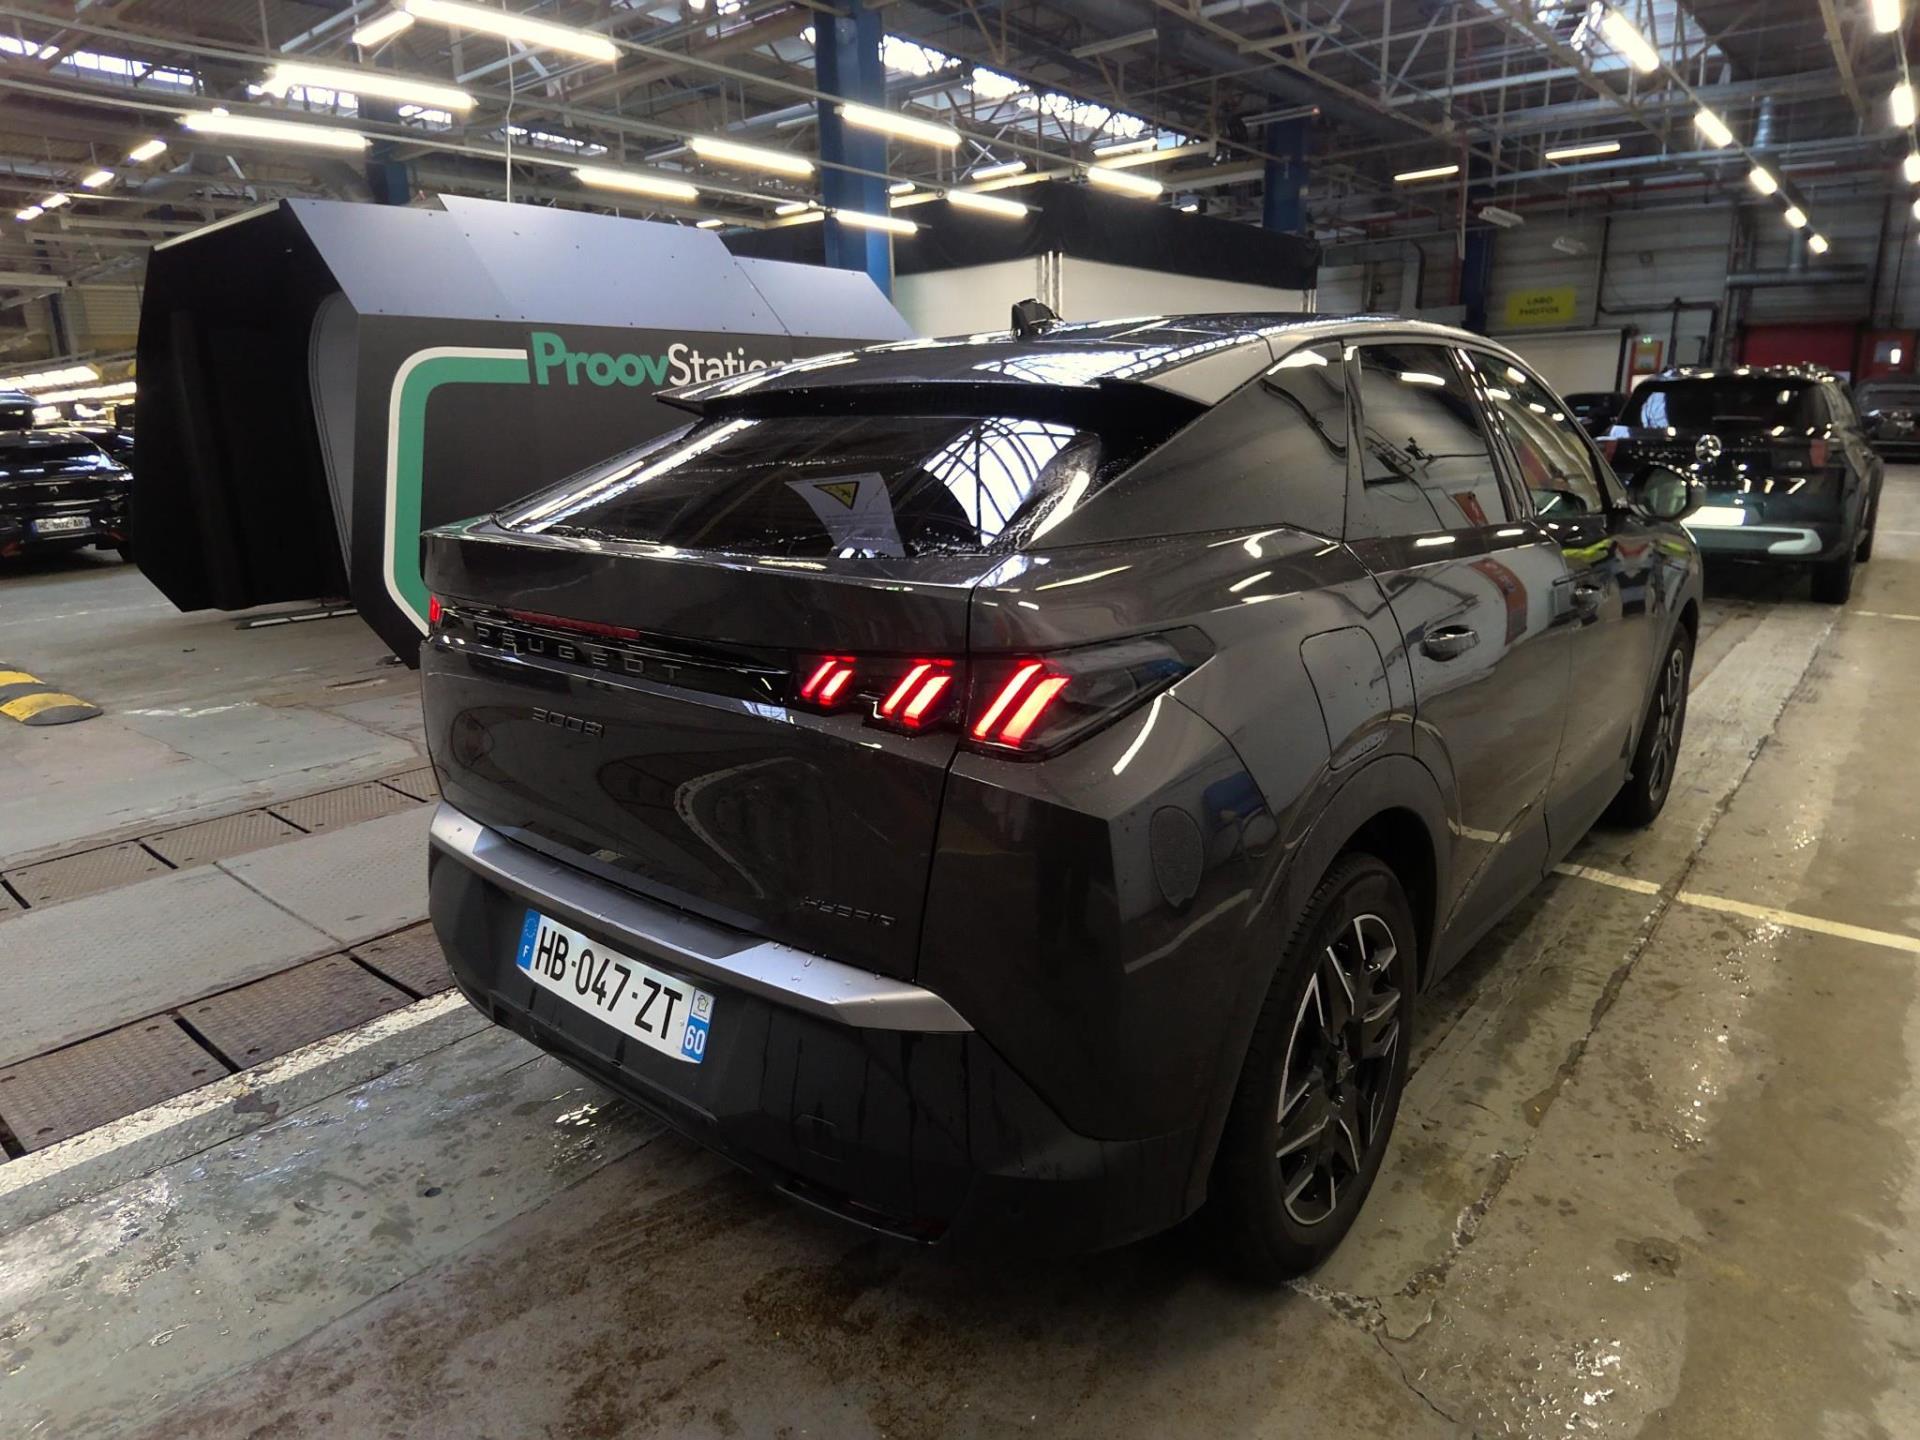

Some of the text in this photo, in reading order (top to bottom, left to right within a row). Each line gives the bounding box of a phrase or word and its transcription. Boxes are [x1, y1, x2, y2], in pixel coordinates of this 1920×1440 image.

[476, 626, 682, 680] PEUGEOT
[532, 706, 605, 737] 3008
[522, 945, 530, 958] F
[535, 926, 683, 1040] HB-047-ZT
[684, 1025, 706, 1054] 60
